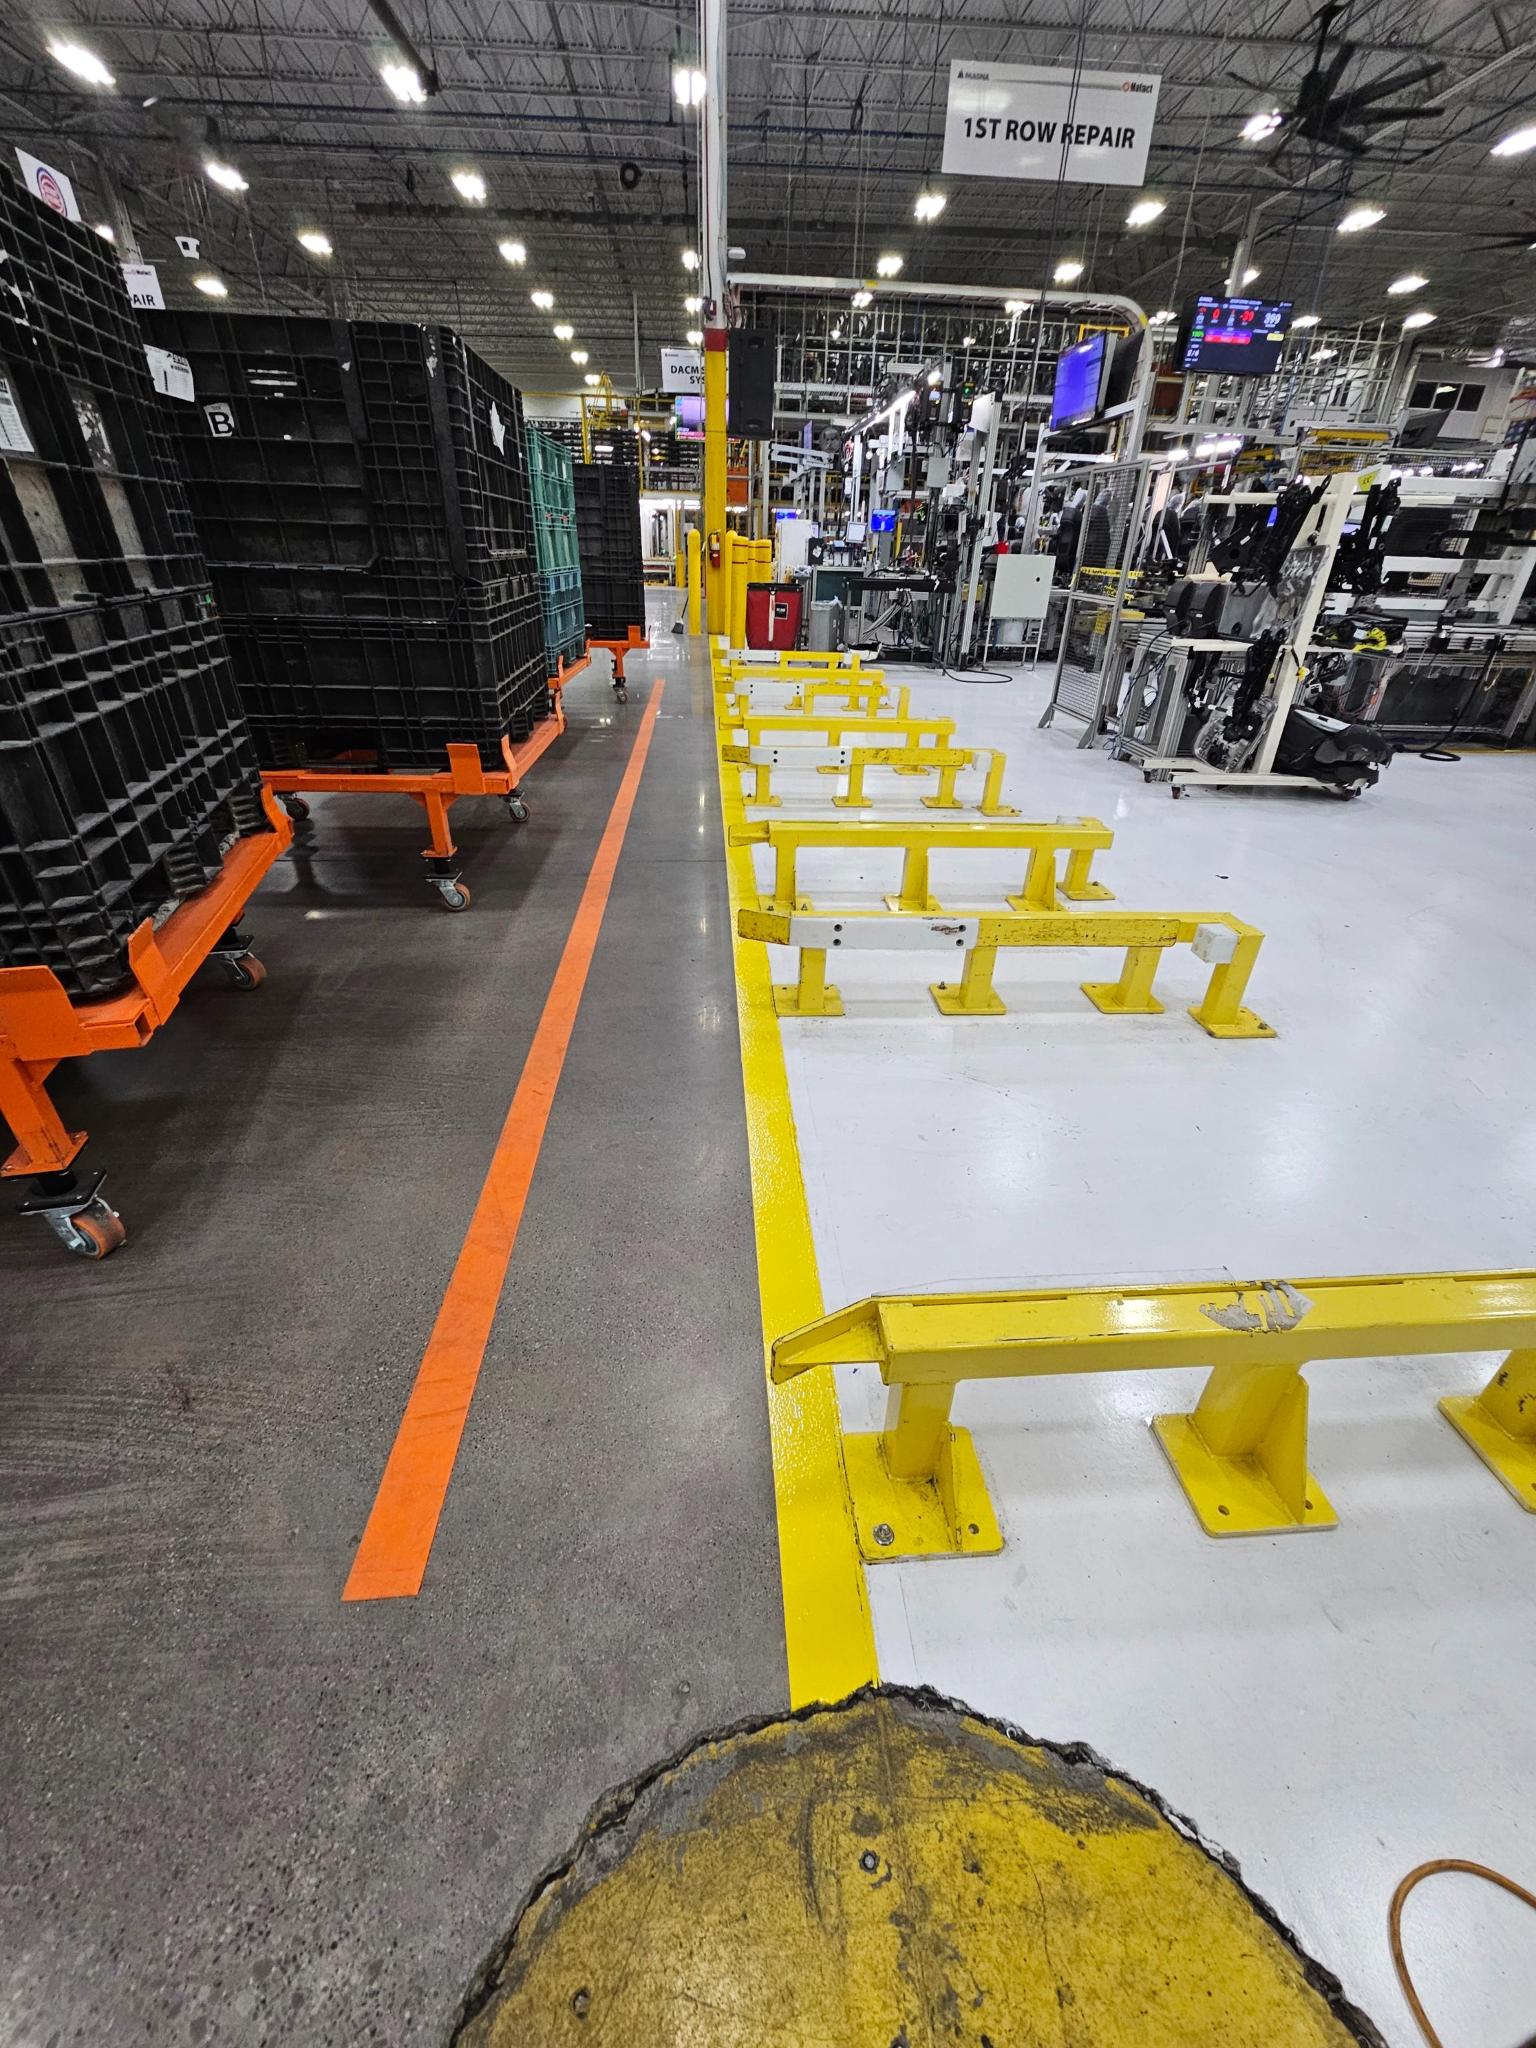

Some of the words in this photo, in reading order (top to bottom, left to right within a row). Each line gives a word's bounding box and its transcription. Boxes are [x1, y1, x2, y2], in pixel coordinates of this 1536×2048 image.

[964, 117, 1001, 139] 1ST
[1005, 119, 1058, 144] ROW
[1061, 124, 1135, 148] REPAIR
[131, 294, 156, 306] AIR
[670, 365, 699, 374] DACM
[208, 412, 234, 434] B
